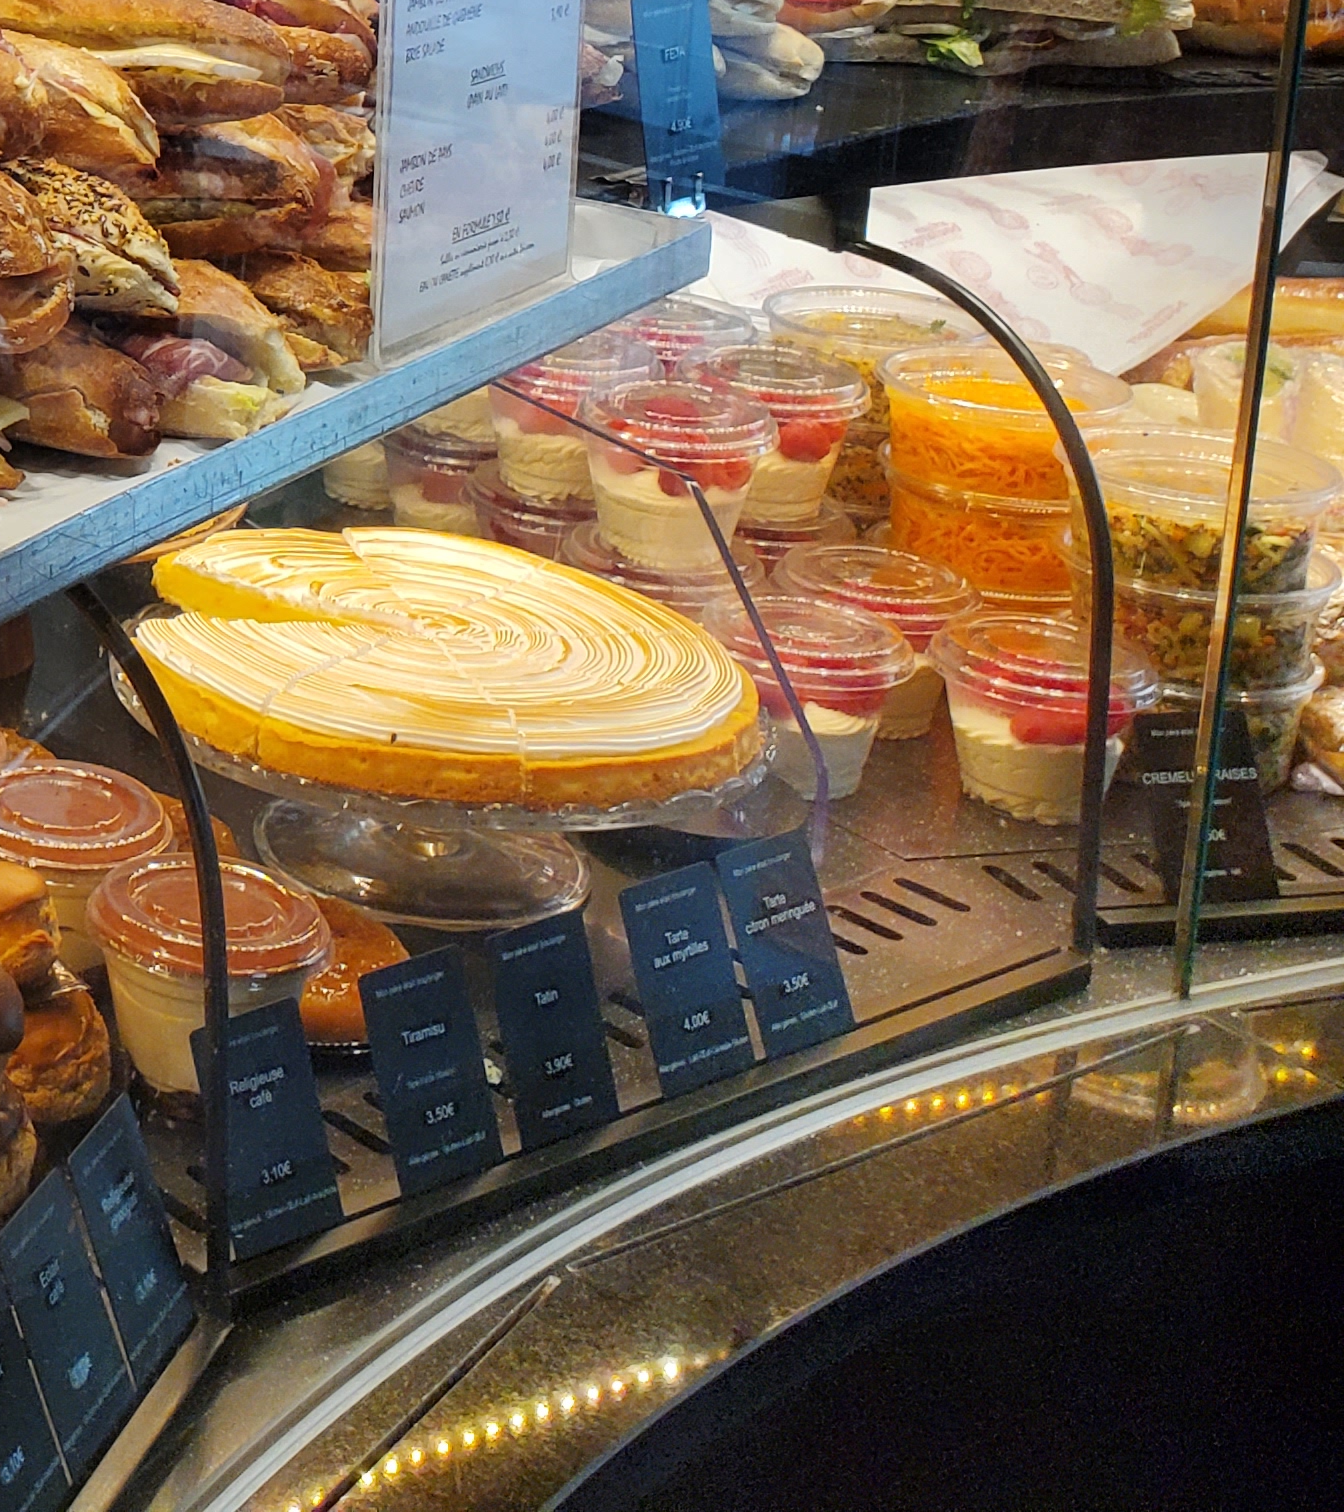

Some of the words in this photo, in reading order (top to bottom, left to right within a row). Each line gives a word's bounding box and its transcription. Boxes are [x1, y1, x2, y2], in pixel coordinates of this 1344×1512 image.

[763, 893, 787, 911] Tarte
[745, 918, 770, 936] citron
[771, 899, 817, 926] meringuée
[665, 928, 689, 946] Tarte
[653, 953, 672, 970] aux
[672, 940, 710, 963] myrtilles
[401, 1021, 447, 1047] Tiramisu
[229, 1065, 285, 1096] Religieuse
[425, 1102, 456, 1125] 3,50€
